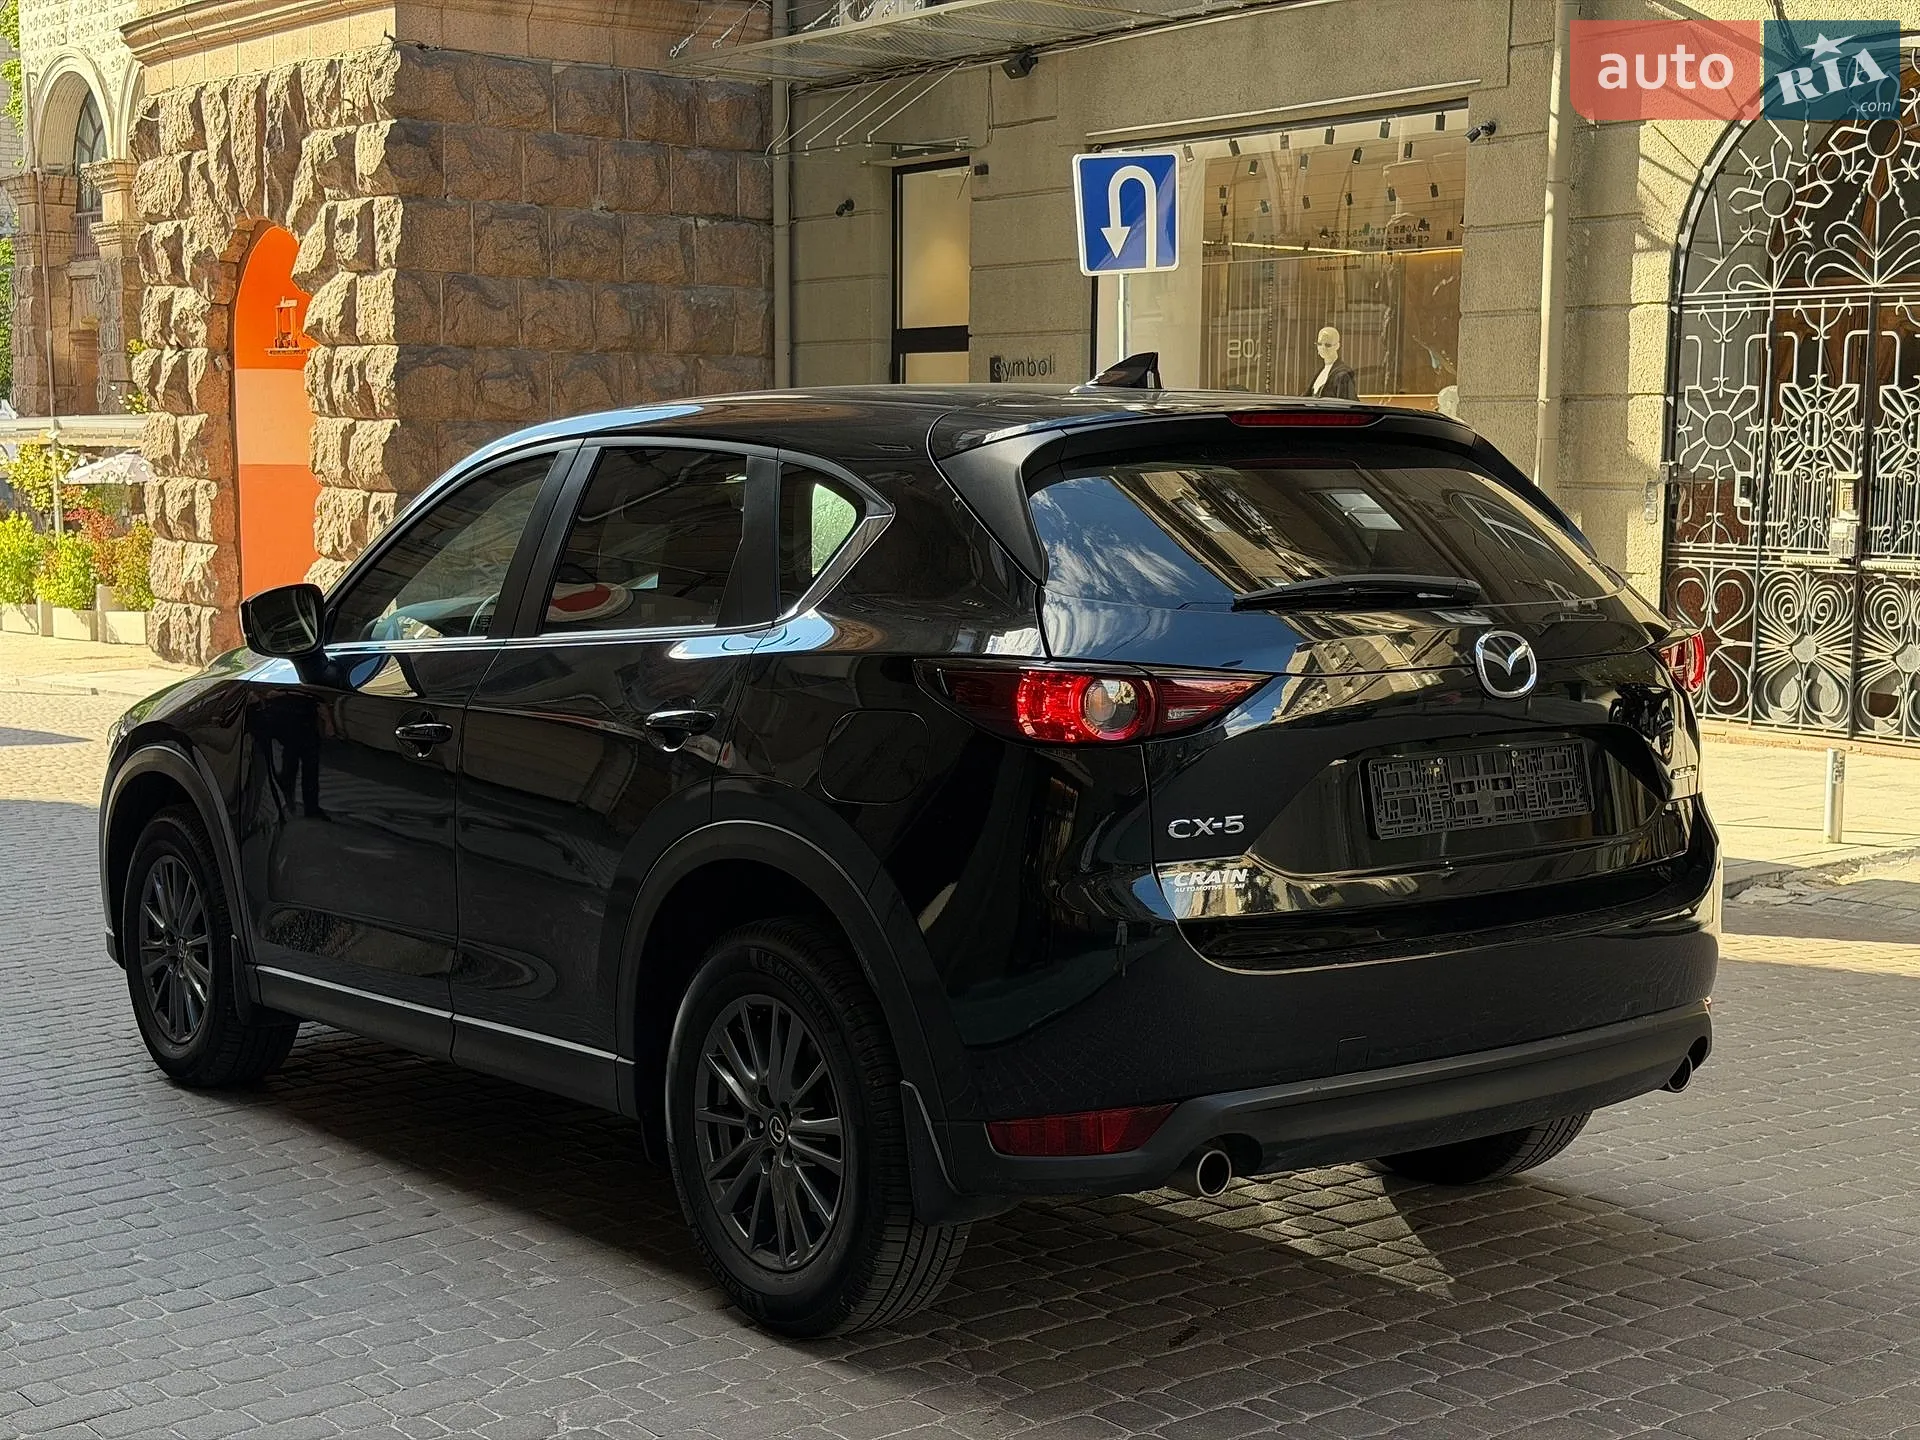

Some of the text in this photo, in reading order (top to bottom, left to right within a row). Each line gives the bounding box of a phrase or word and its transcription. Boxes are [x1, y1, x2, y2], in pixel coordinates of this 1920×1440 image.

[993, 354, 1053, 382] symbol
[1168, 814, 1245, 839] CX-5
[1174, 882, 1246, 893] AUTOMOTIVE TEAM
